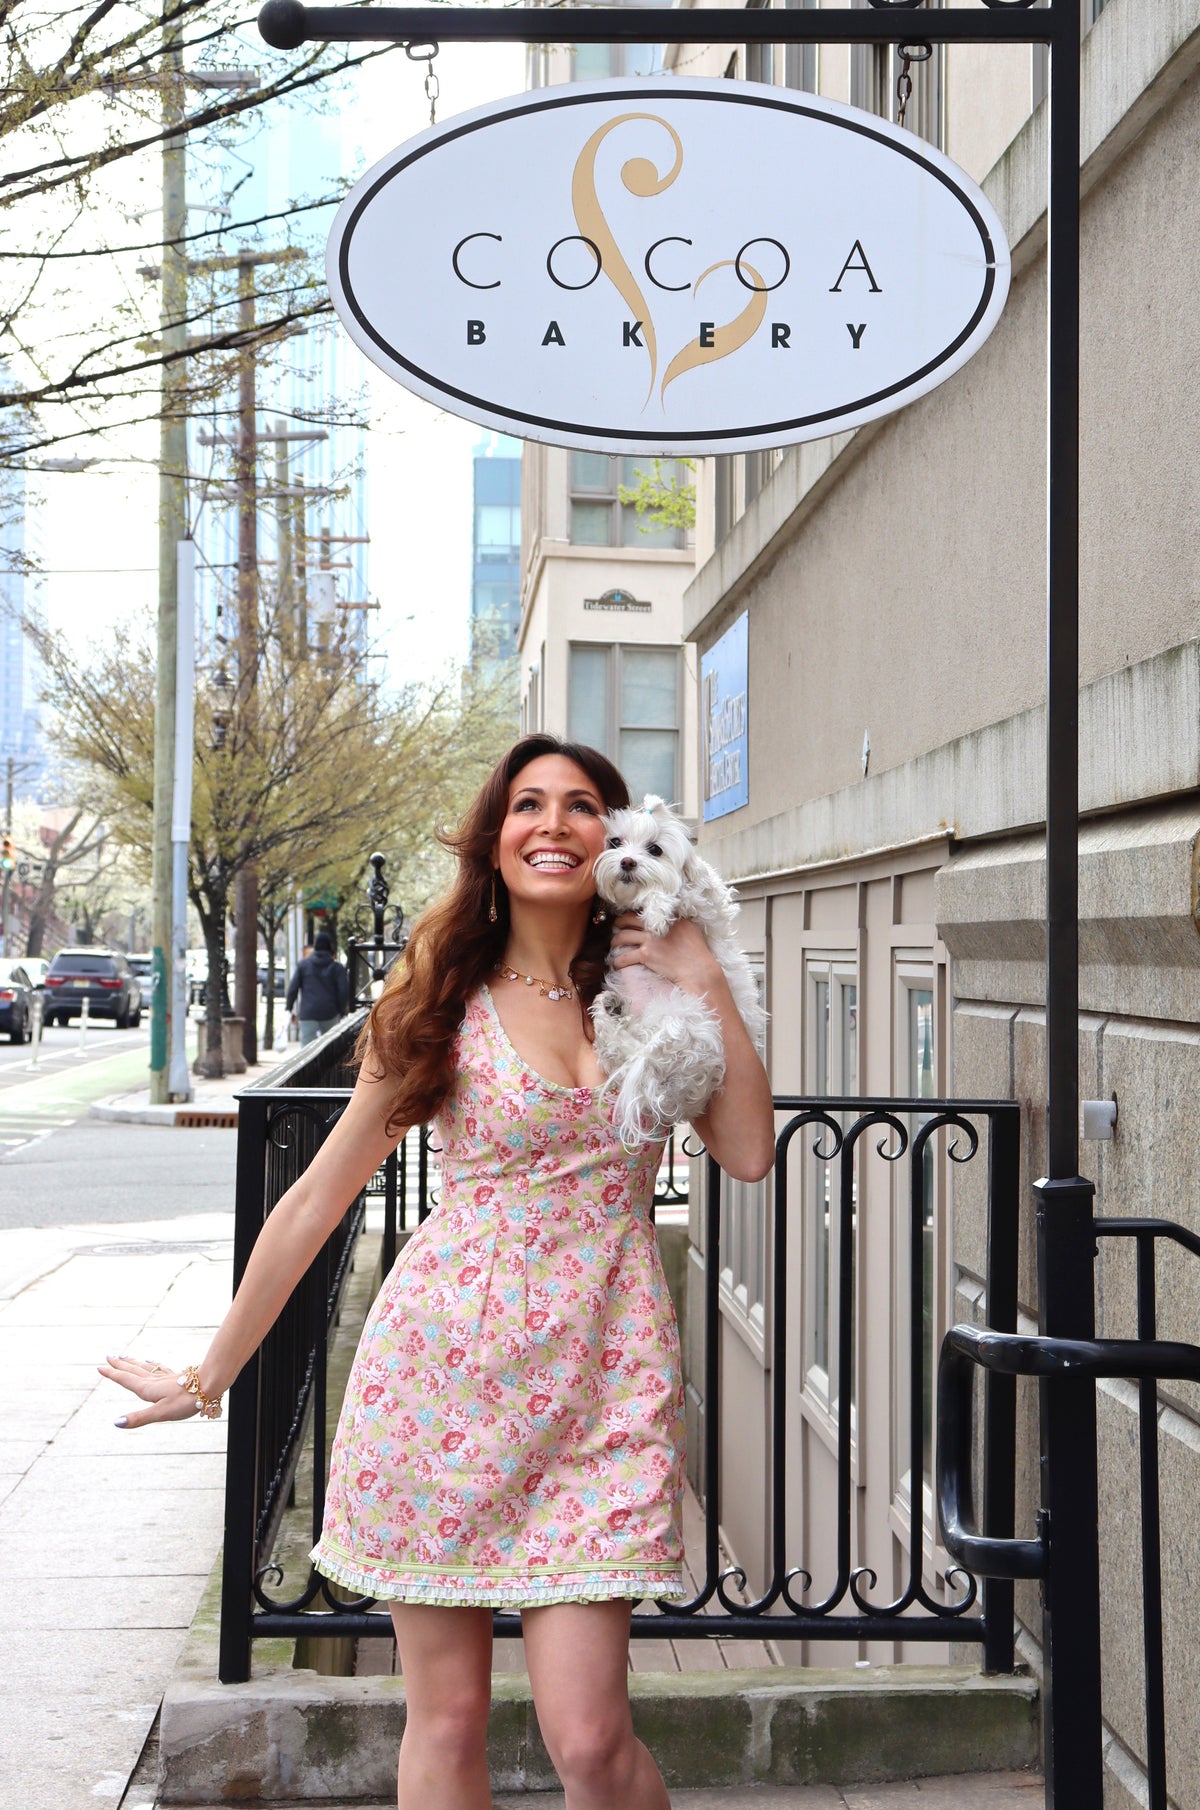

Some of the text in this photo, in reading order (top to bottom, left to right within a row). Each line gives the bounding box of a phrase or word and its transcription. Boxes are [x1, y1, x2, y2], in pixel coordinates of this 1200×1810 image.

[452, 232, 883, 293] COCOA
[467, 319, 868, 350] BAKERY
[585, 601, 652, 612] Tidewater Street
